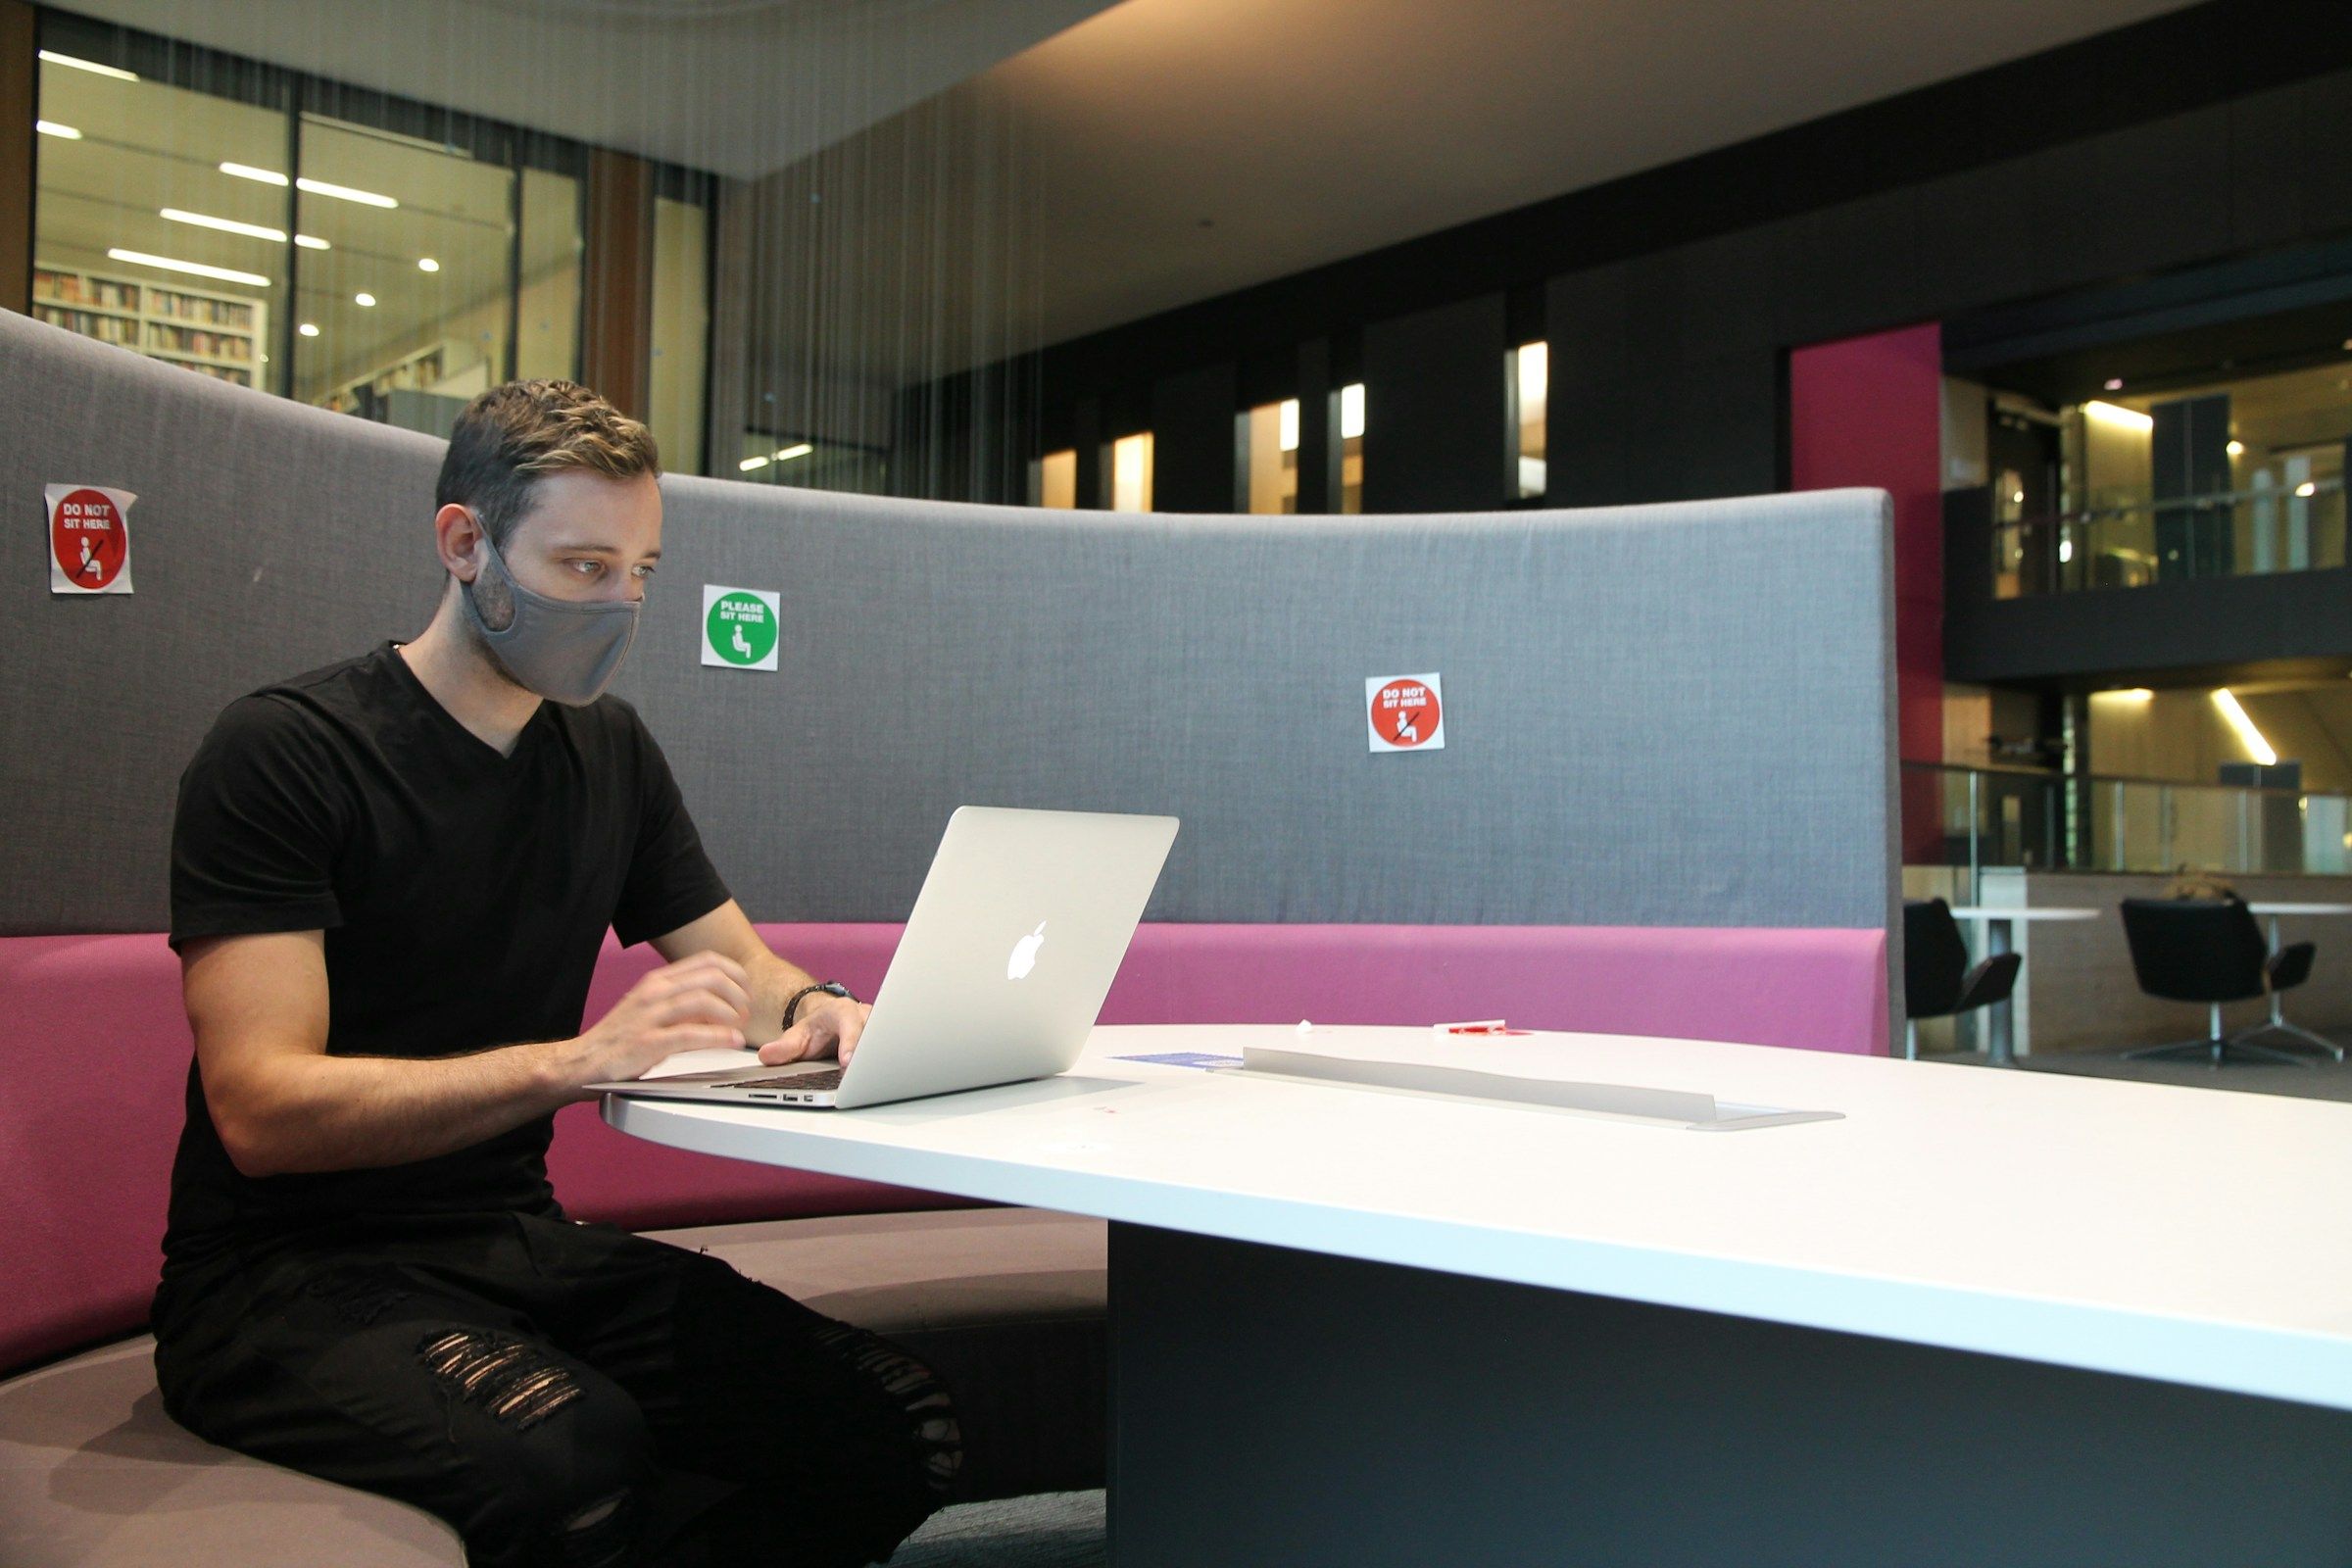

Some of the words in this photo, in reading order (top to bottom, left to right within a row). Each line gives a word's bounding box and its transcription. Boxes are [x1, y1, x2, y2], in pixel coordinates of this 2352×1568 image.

[63, 503, 80, 515] DO
[83, 504, 111, 516] NOT
[64, 518, 79, 529] SIT
[82, 518, 111, 530] HERE
[720, 601, 764, 613] PLEASE
[738, 613, 764, 623] HERE
[1383, 689, 1399, 699] DO
[1401, 687, 1426, 697] NOT
[1383, 699, 1398, 709] SIT
[1400, 698, 1427, 707] HERE
